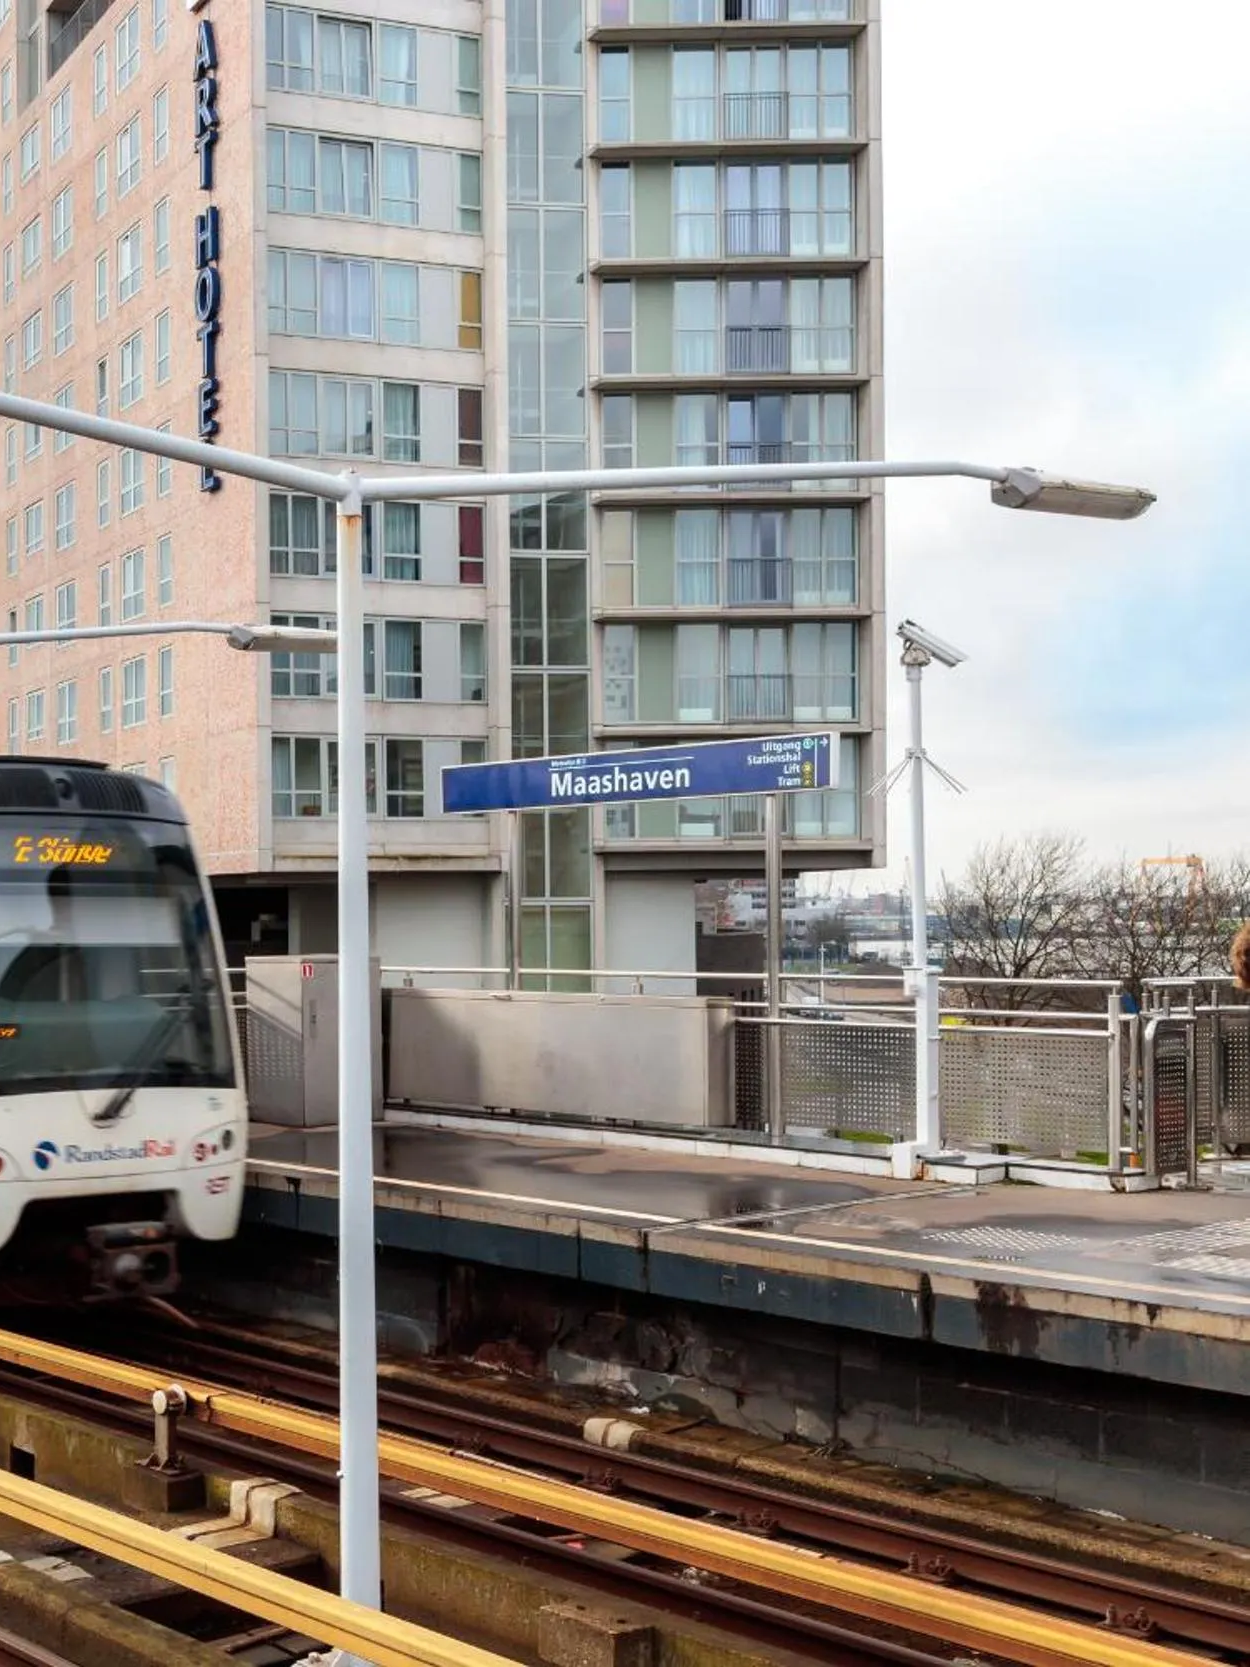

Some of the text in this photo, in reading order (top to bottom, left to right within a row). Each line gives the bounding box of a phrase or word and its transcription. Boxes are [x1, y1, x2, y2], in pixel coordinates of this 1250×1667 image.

[193, 18, 222, 493] ART HOTEL
[762, 741, 801, 753] Uitgang
[747, 752, 801, 766] Stationshal
[783, 763, 800, 774] Lift
[550, 766, 690, 797] Maashaven
[777, 776, 801, 787] Tram
